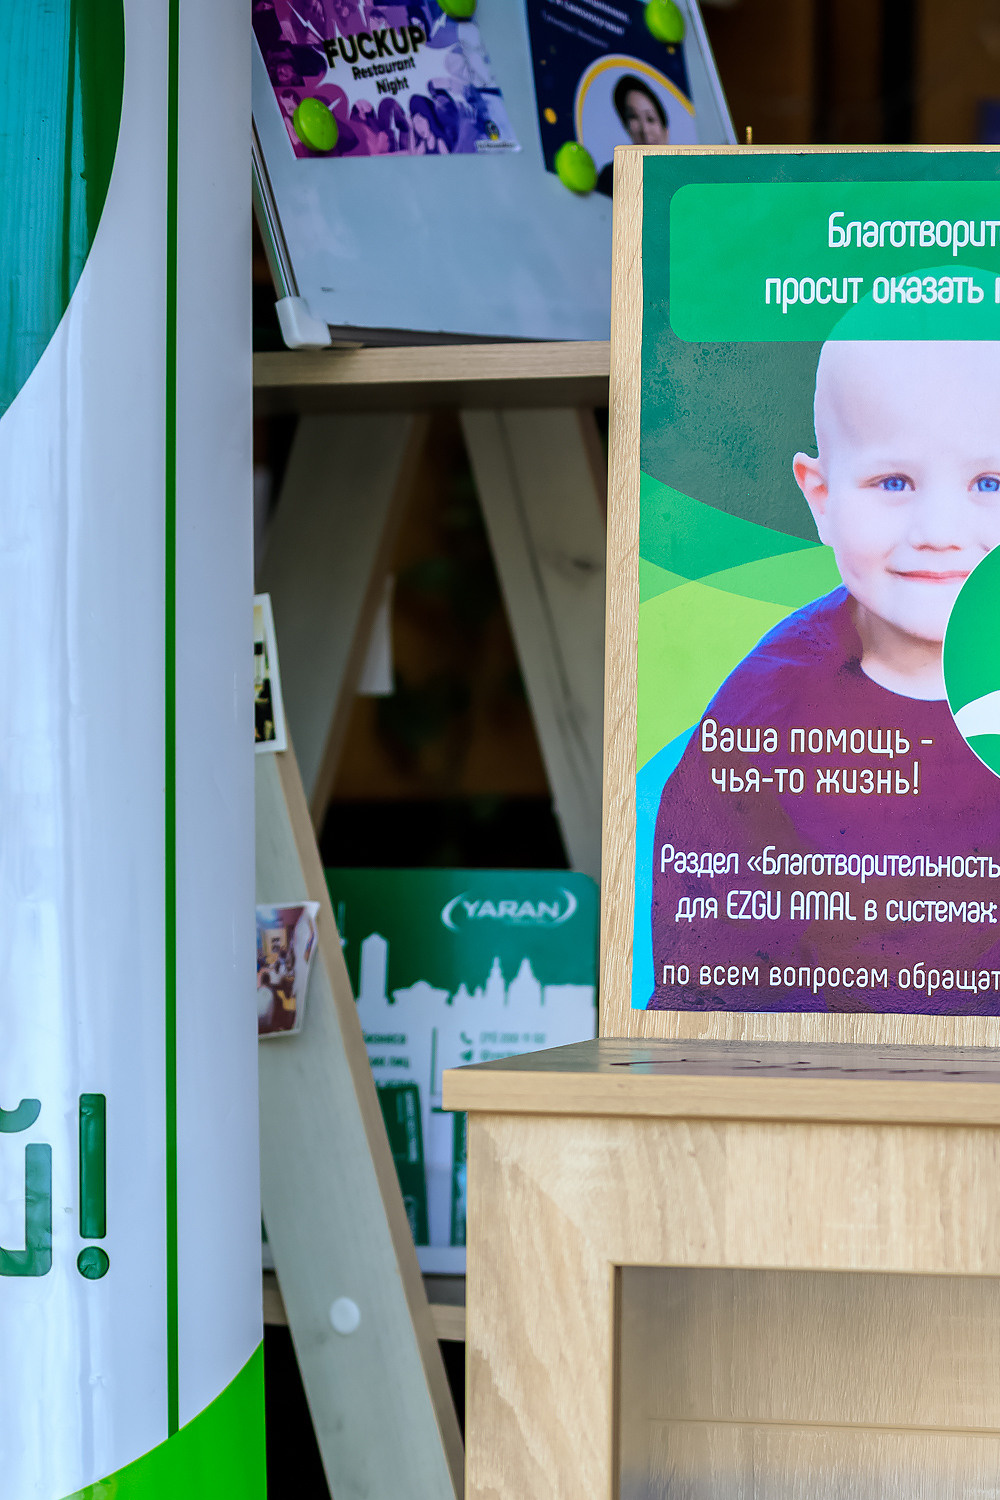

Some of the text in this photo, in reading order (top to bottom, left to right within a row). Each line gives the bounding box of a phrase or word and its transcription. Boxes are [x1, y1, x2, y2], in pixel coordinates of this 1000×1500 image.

[322, 25, 428, 69] FUCKUP
[351, 56, 416, 81] Restaurant
[376, 77, 410, 96] Night
[764, 277, 864, 314] просит
[872, 276, 985, 305] оказать
[700, 718, 778, 753] Ваша
[790, 727, 911, 759] помощь
[710, 760, 920, 795] чья-то жизнь!
[659, 843, 739, 878] Раздел
[462, 900, 560, 918] YARAN
[674, 889, 998, 924] для EZGU AMAL в системах:
[662, 964, 690, 986] по
[699, 965, 759, 987] всем
[768, 965, 888, 994] вопросам
